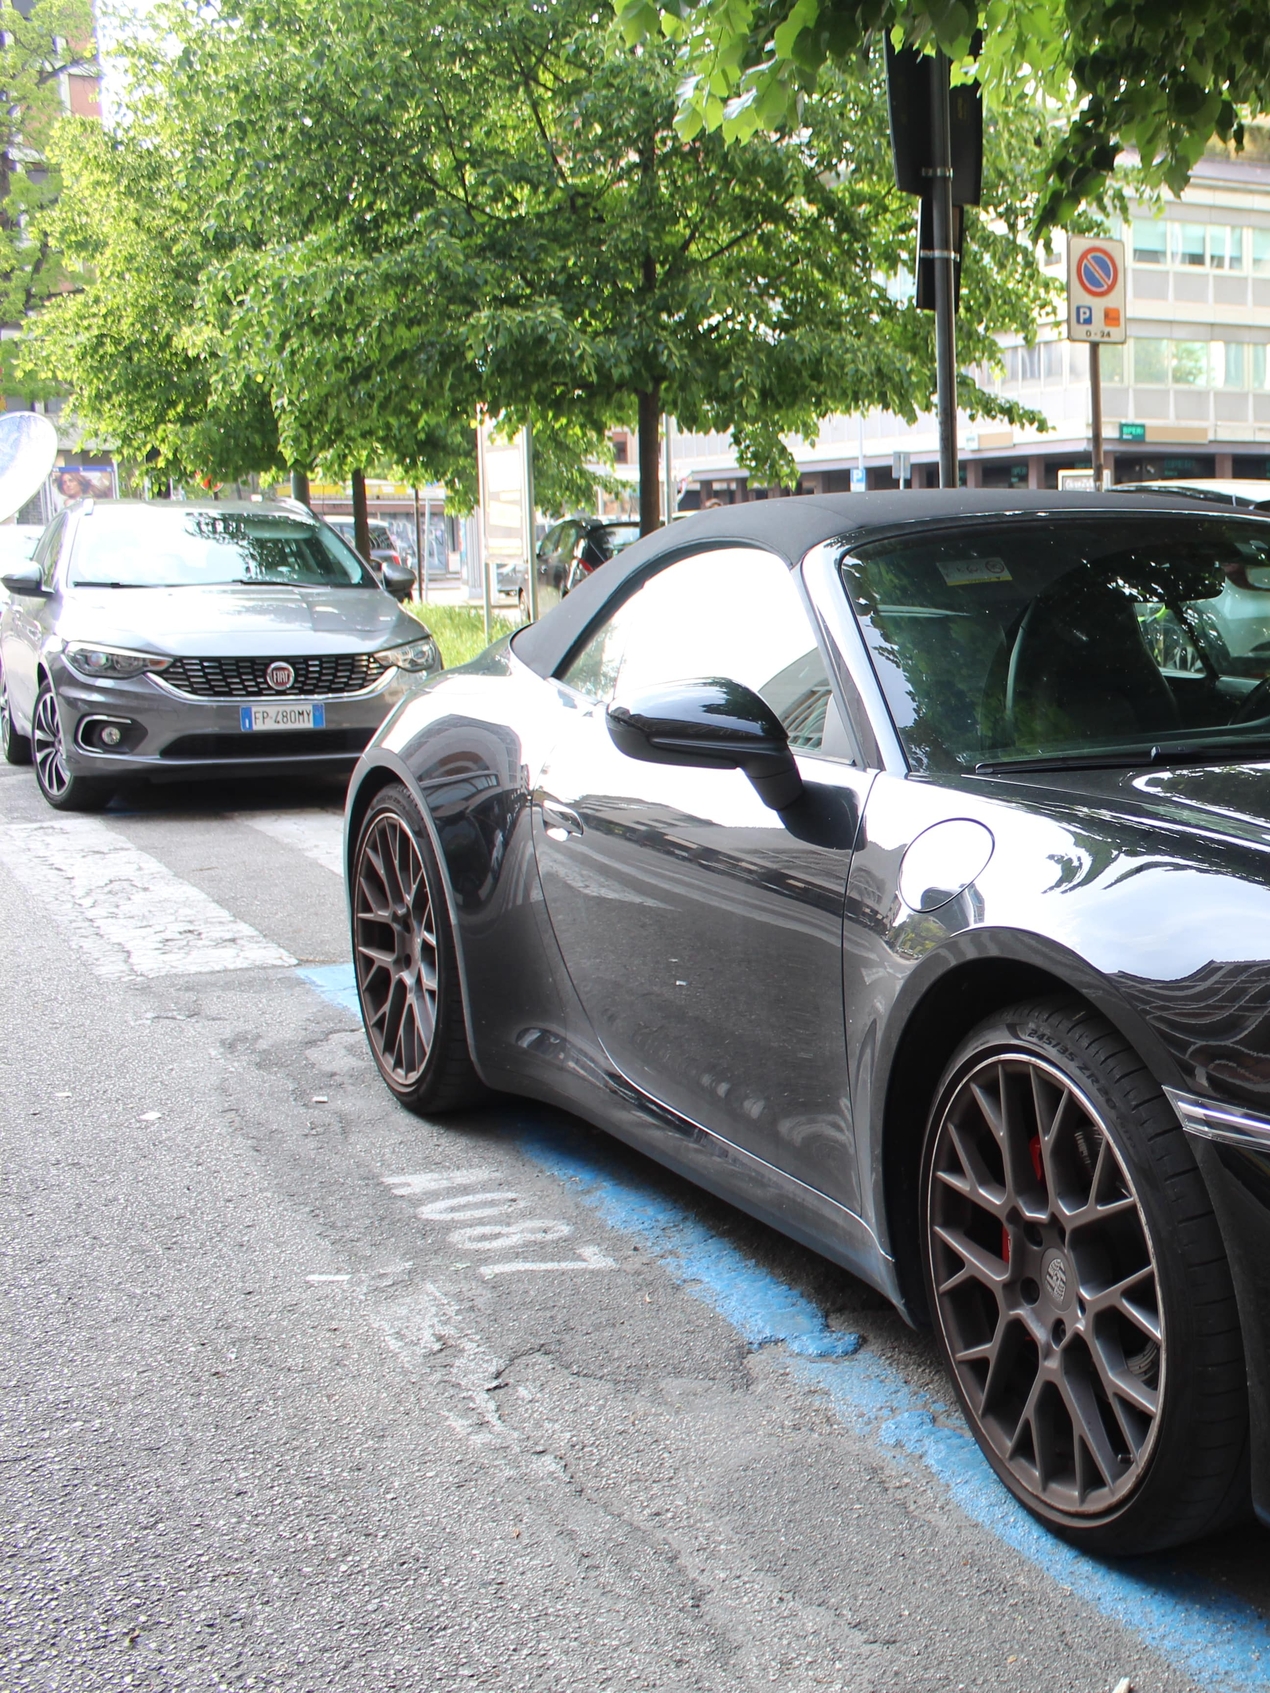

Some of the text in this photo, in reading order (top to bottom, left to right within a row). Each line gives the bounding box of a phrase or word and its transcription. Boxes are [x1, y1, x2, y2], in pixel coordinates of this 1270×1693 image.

[1079, 307, 1090, 324] P
[1100, 330, 1112, 339] 24
[853, 472, 863, 483] P
[273, 671, 288, 683] FIAT
[1027, 1028, 1117, 1110] 245/35 ZR20
